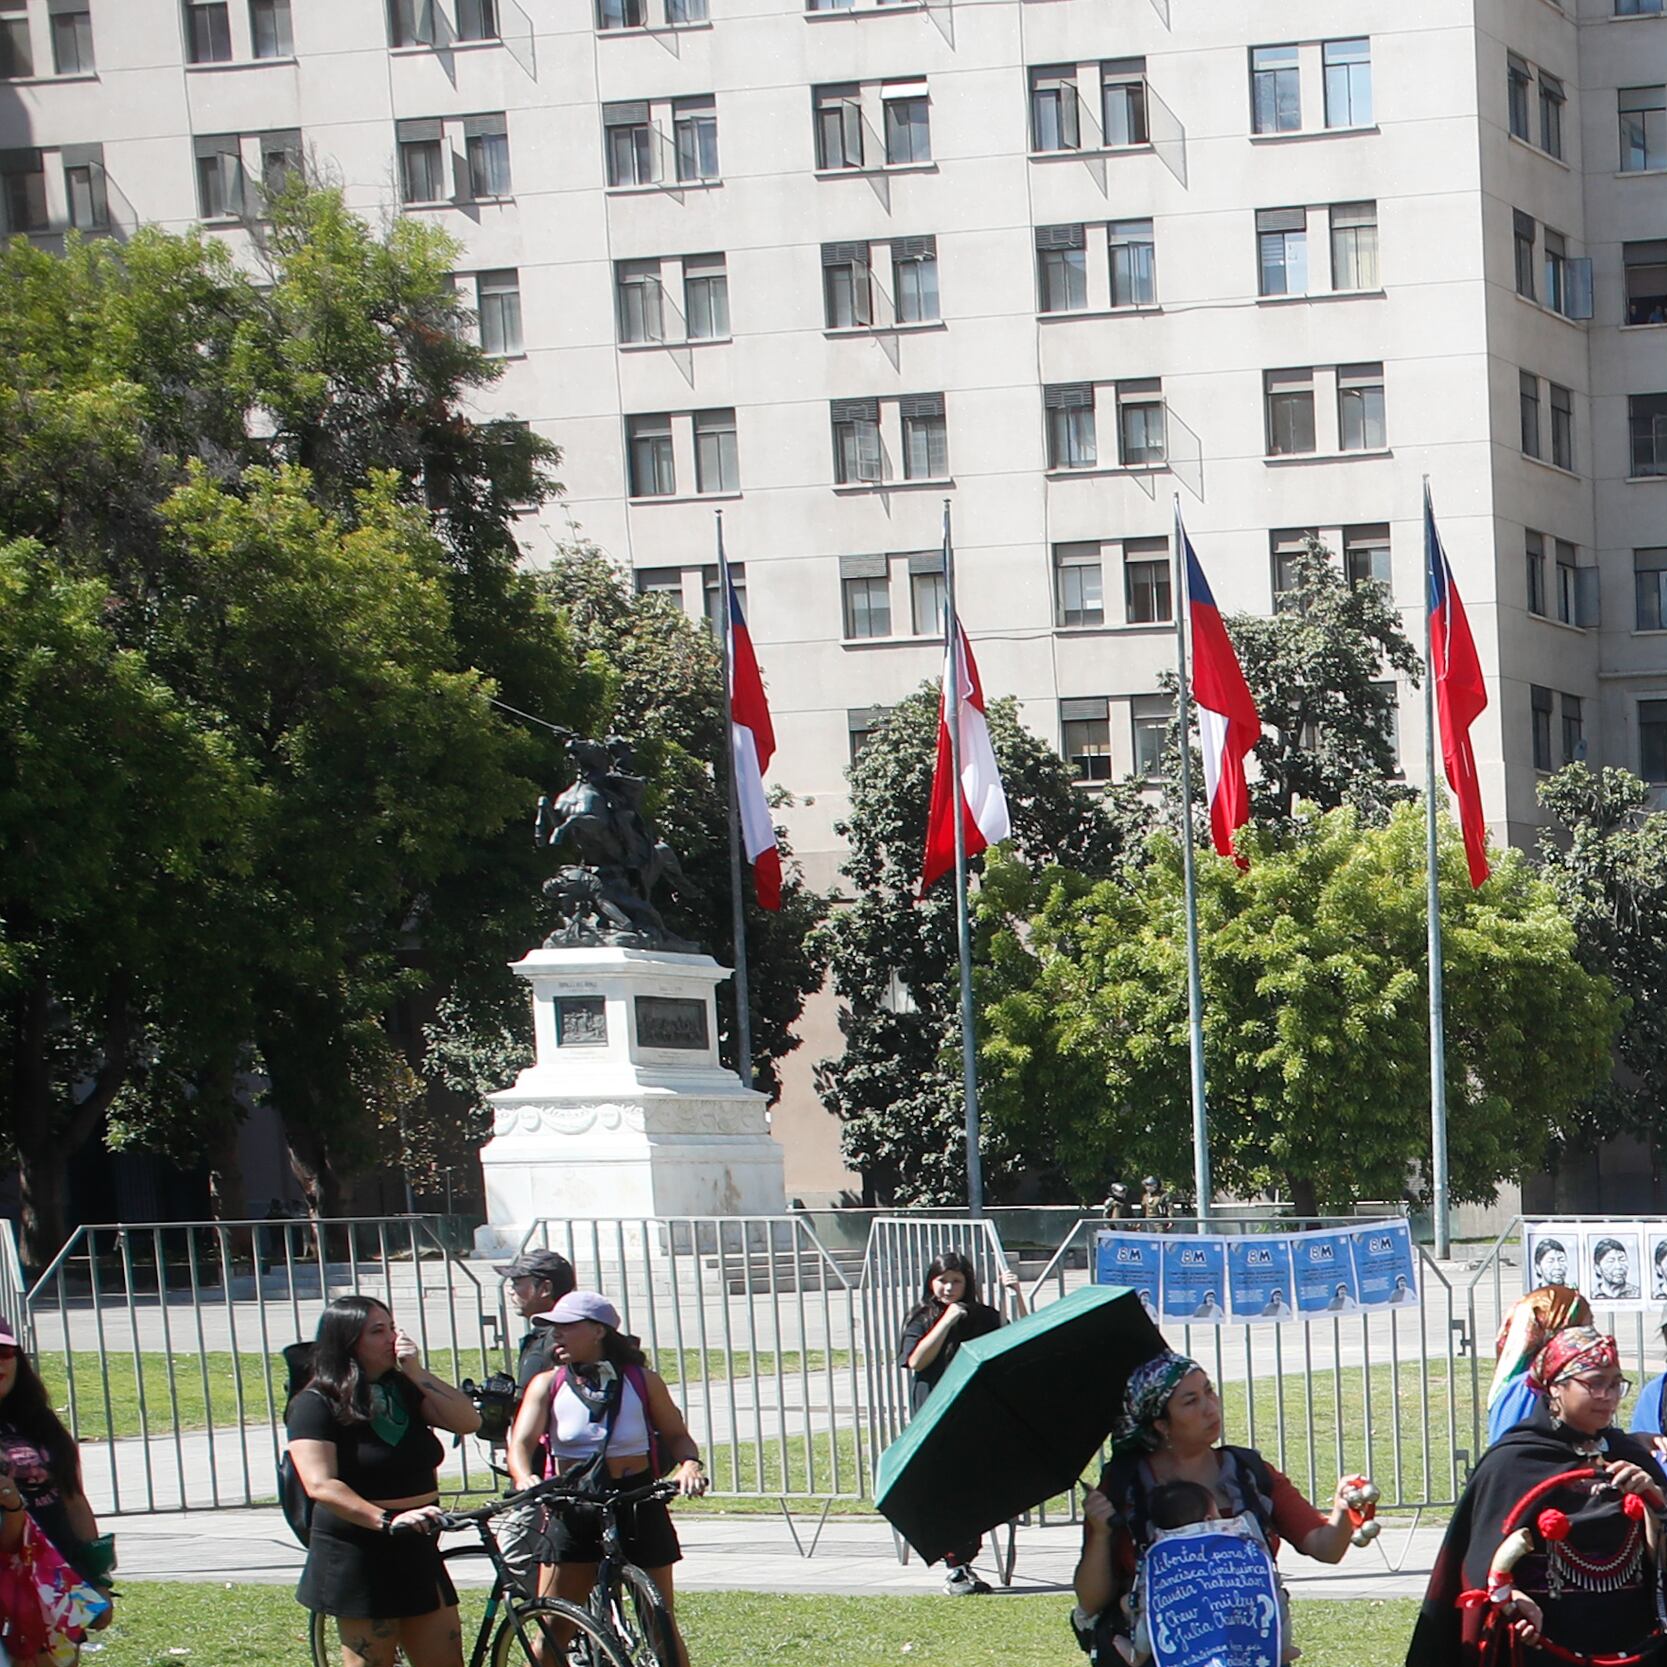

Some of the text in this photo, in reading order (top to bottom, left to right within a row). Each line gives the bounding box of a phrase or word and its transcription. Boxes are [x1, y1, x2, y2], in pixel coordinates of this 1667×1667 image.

[1369, 1236, 1393, 1252] 8M
[1117, 1248, 1142, 1262] 8M
[1181, 1250, 1206, 1264] 8M
[1247, 1250, 1272, 1264] 8M
[1310, 1244, 1334, 1259] 8M
